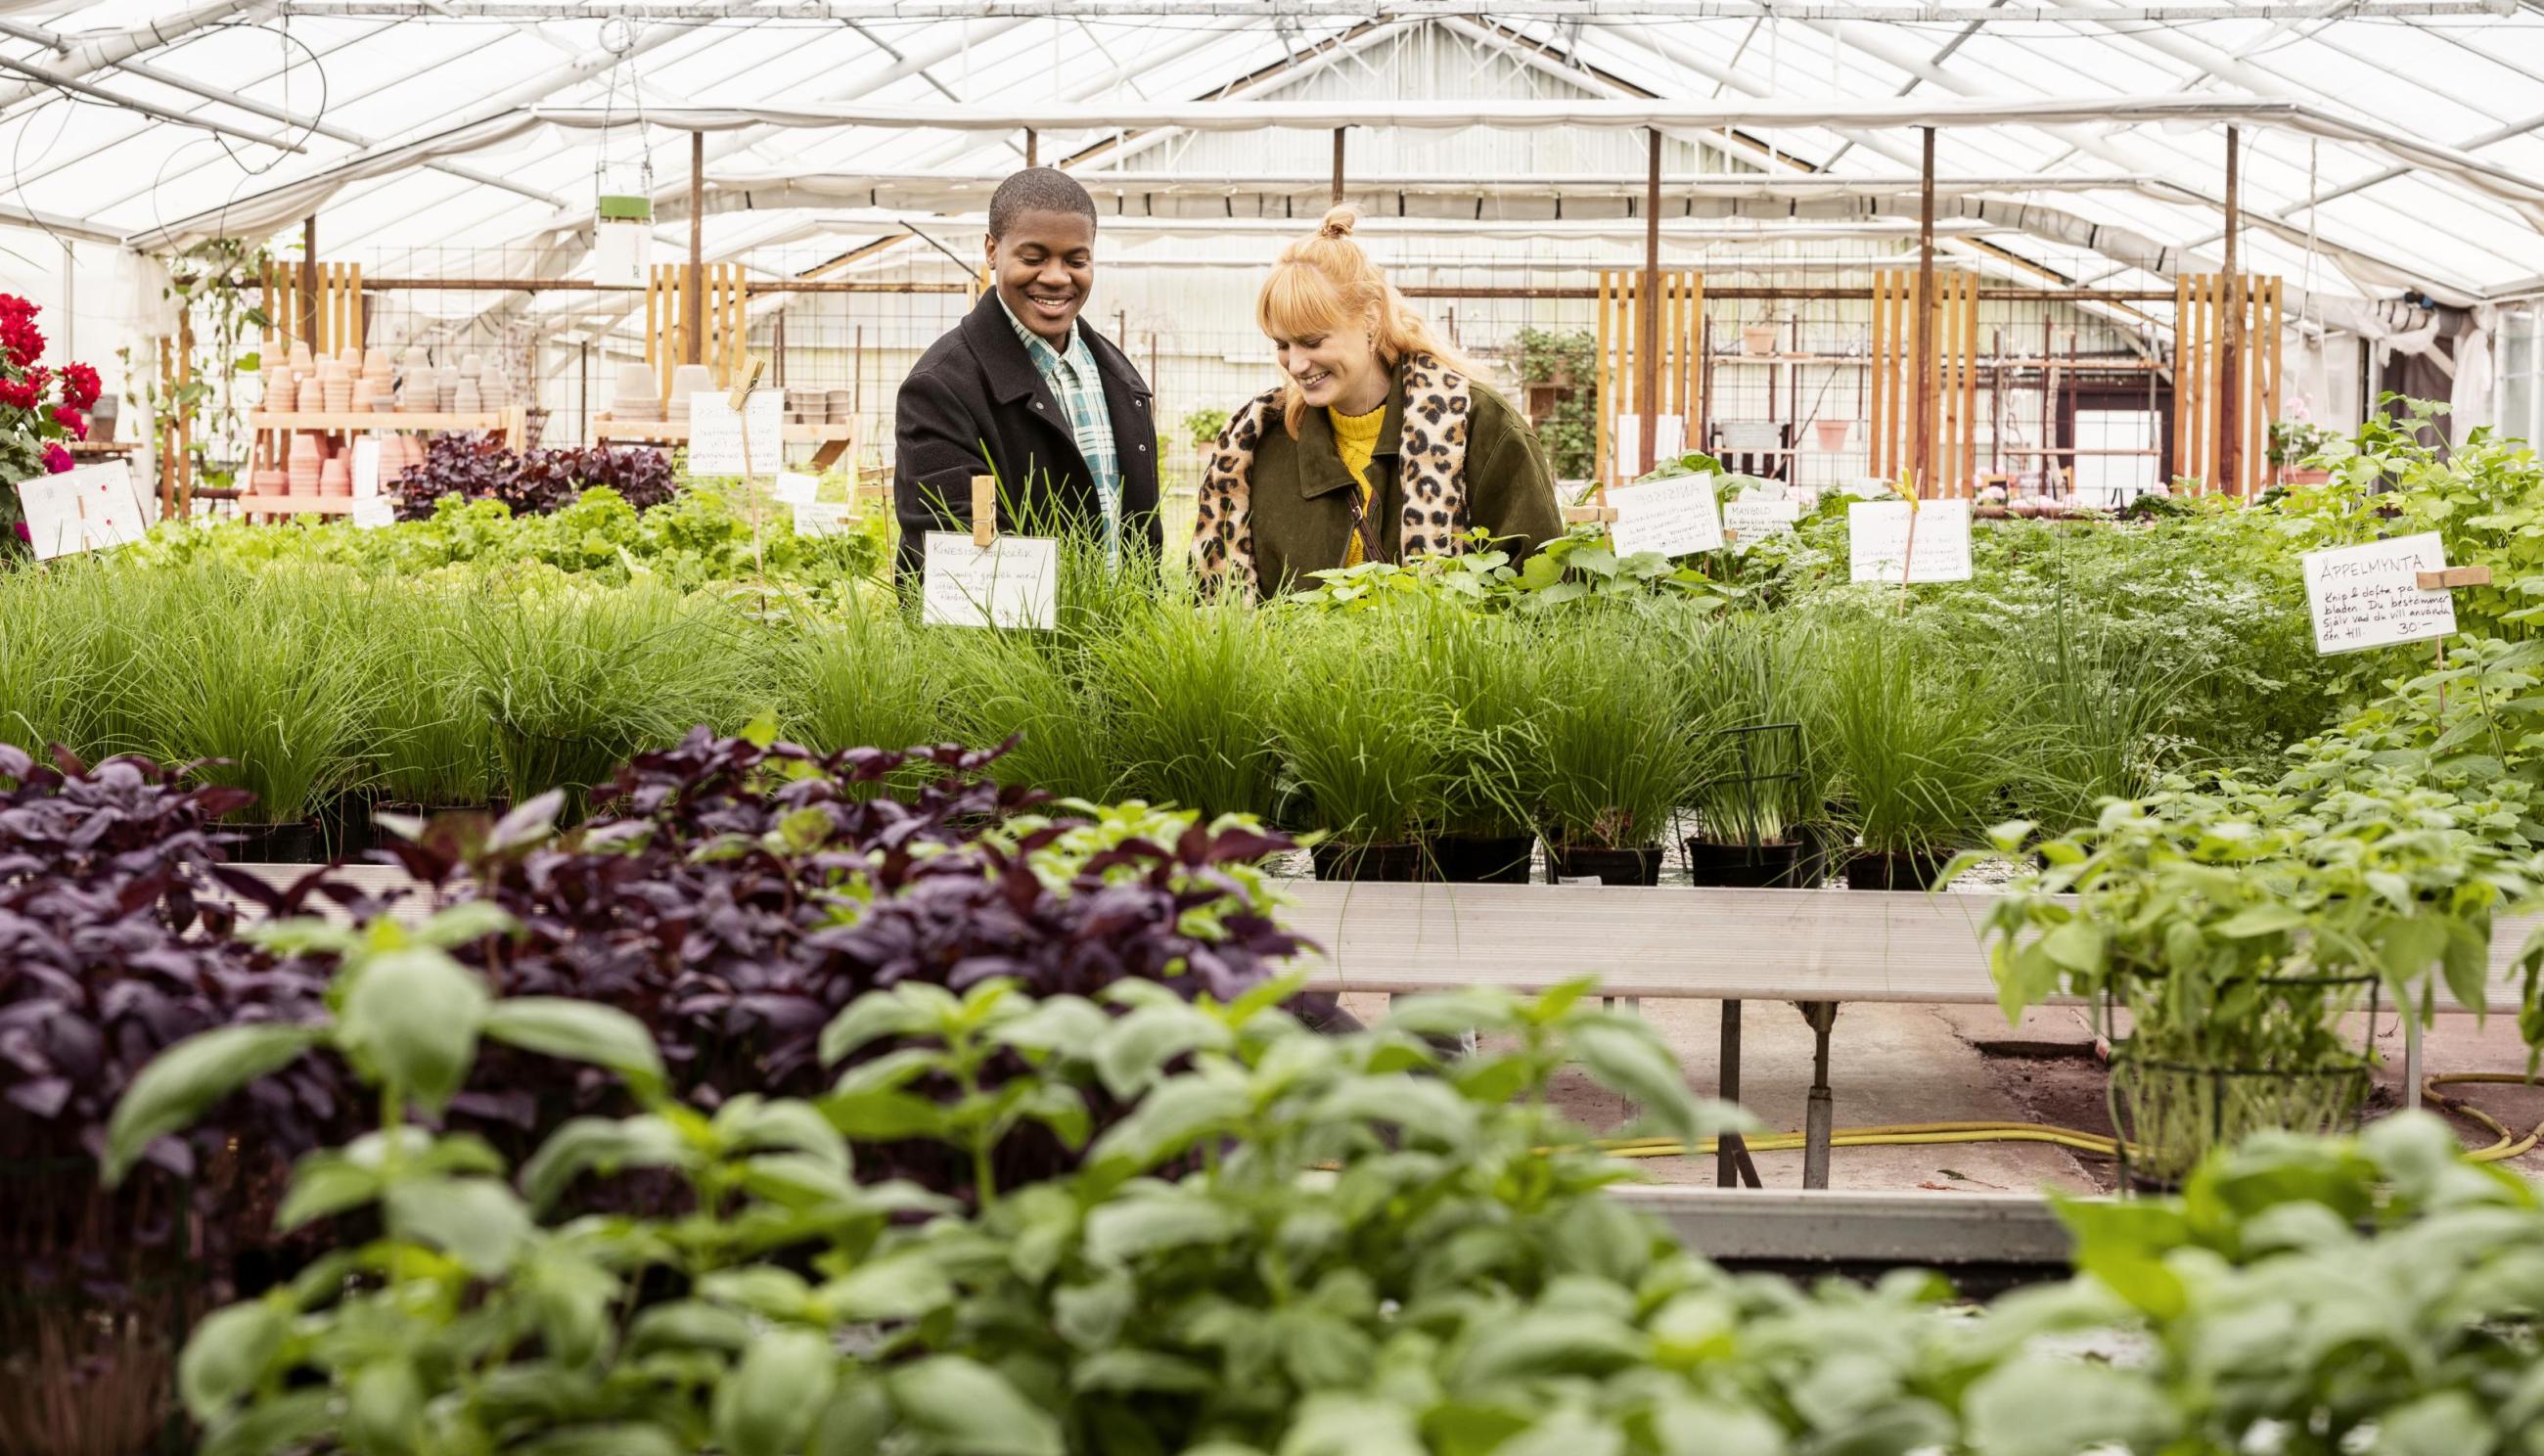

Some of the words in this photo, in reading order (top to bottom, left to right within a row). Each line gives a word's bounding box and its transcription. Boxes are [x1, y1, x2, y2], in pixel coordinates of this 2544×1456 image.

[2320, 554, 2425, 583] ÄPPELMYNTA
[2324, 591, 2348, 606] Knip
[2362, 584, 2392, 599] dofta
[2368, 600, 2384, 610] Du
[2390, 595, 2449, 608] bestämmer
[2374, 611, 2387, 621] du
[2390, 609, 2406, 619] vill
[2409, 605, 2451, 617] använda
[2323, 631, 2340, 642] den
